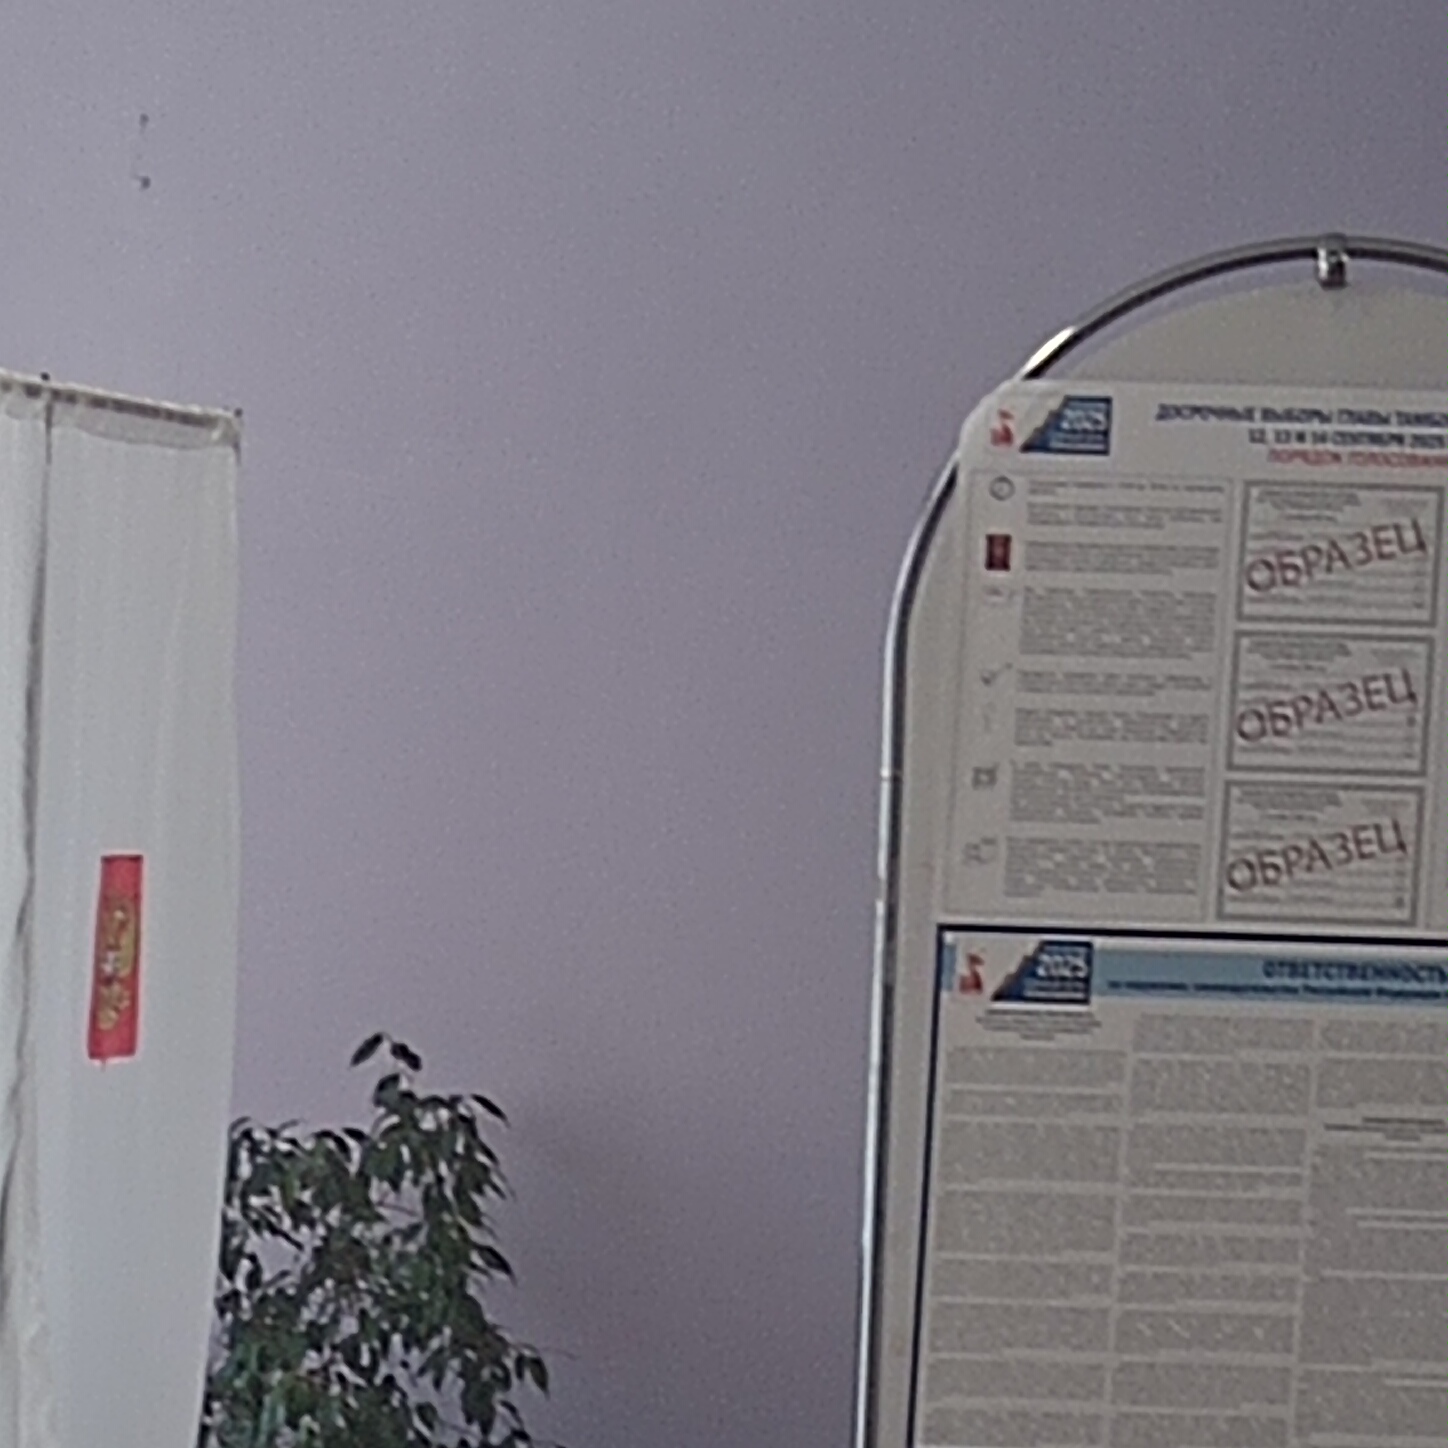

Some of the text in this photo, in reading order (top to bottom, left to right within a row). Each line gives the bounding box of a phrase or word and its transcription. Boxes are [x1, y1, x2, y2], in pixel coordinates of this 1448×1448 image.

[1246, 518, 1426, 592] ОБРАЗЕЦ
[1236, 669, 1418, 741] ОБРАЗЕЦ
[1226, 819, 1408, 892] ОБРАЗЕЦ
